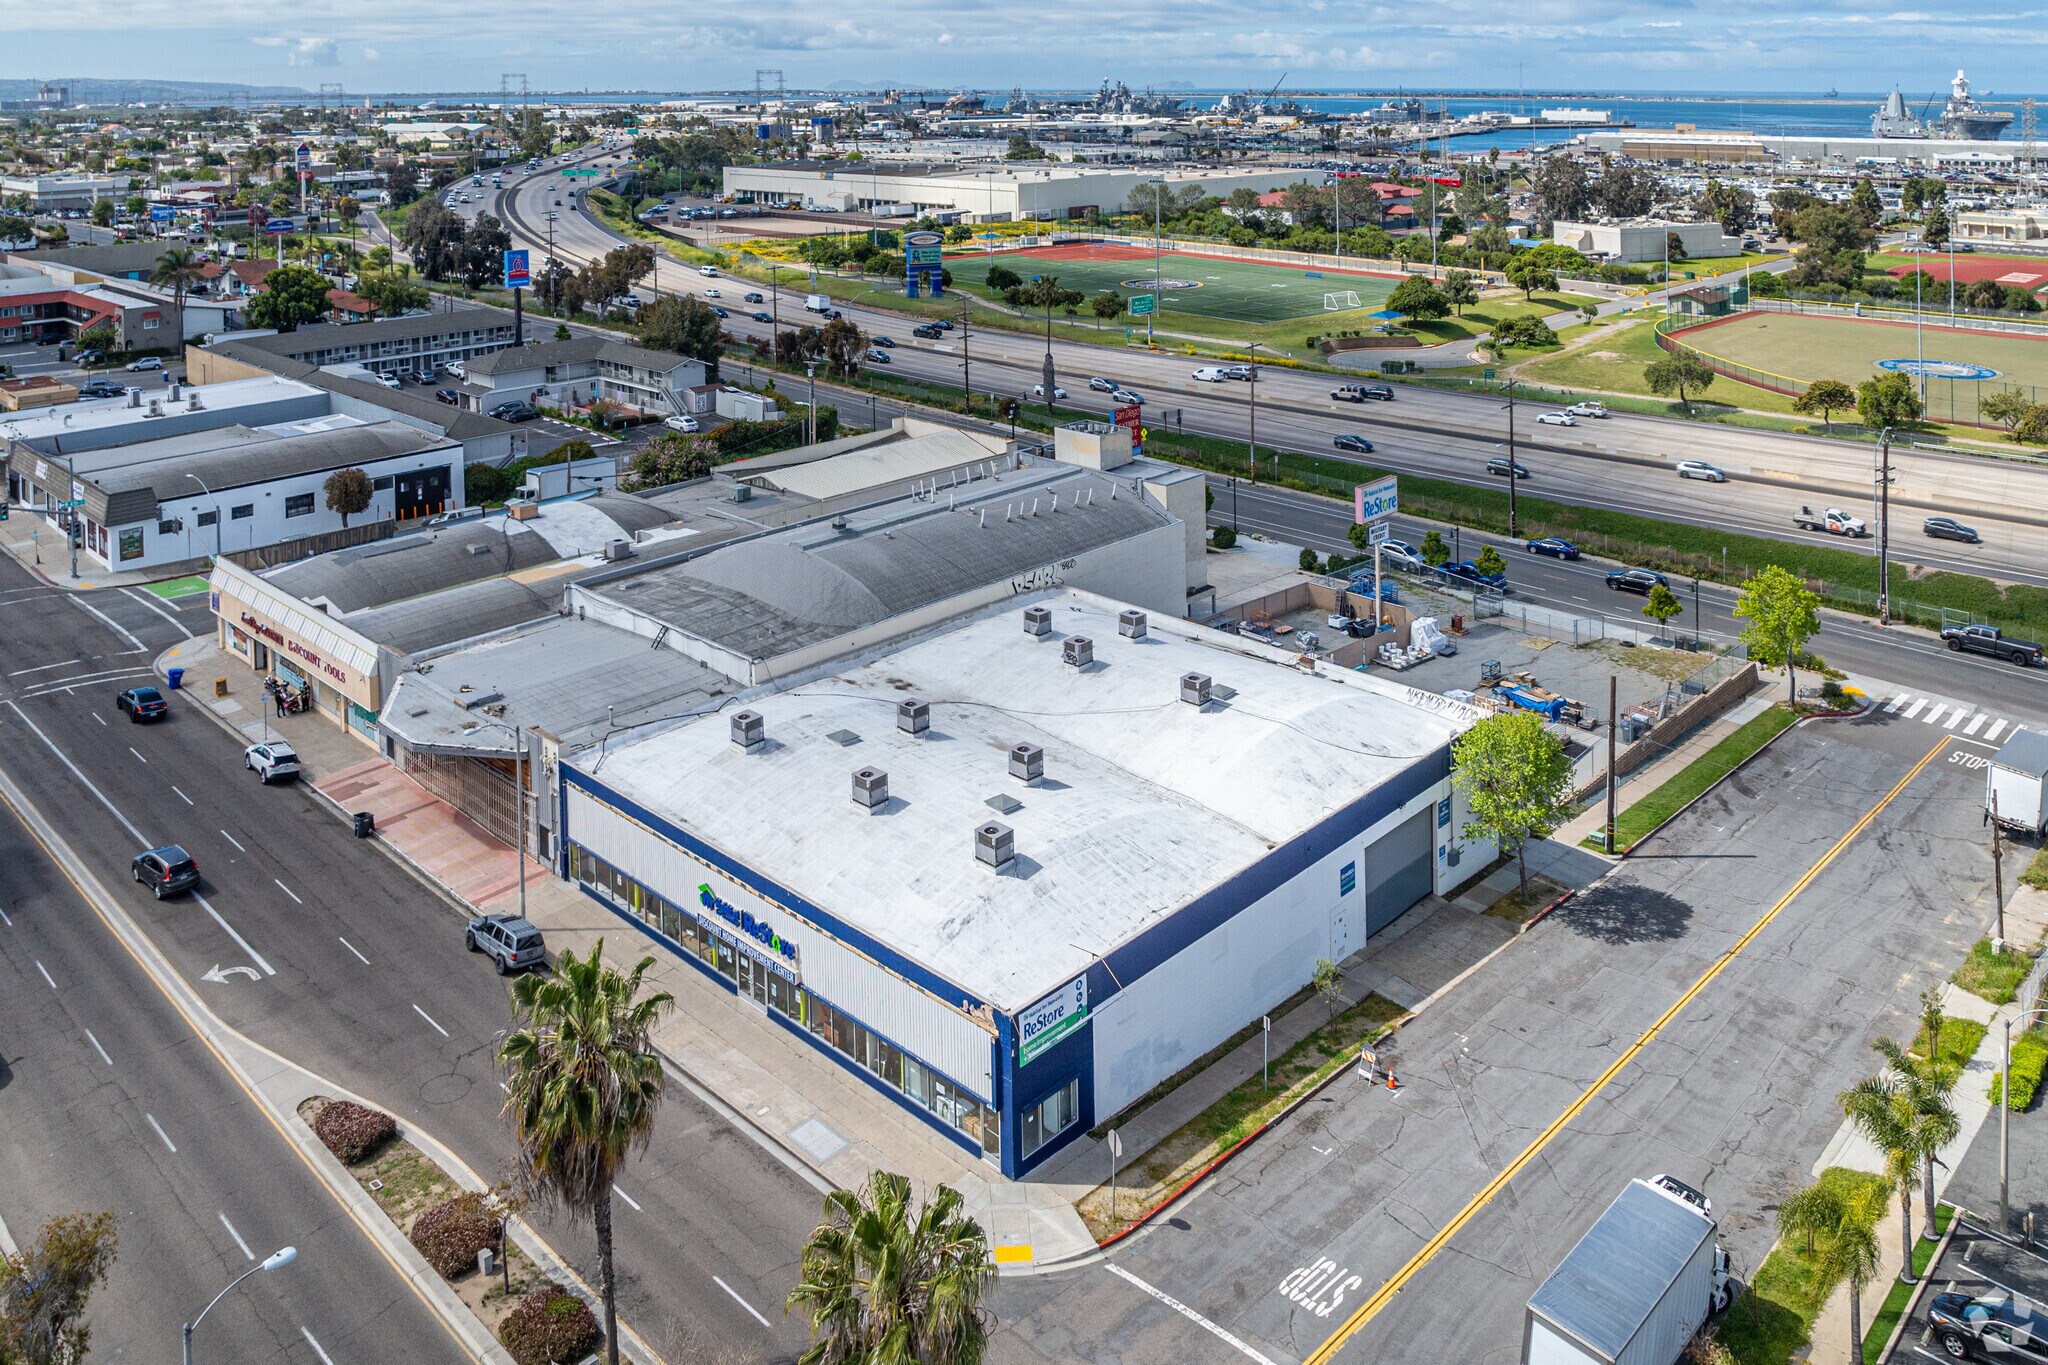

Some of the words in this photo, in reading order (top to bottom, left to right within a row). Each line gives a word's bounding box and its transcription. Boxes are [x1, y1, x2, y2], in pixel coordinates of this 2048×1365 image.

[513, 256, 524, 271] 6
[1115, 411, 1125, 421] San
[1125, 408, 1140, 418] Diego
[1363, 495, 1397, 518] ReStore
[1371, 525, 1387, 535] MILITARY
[1372, 532, 1386, 541] CREDIT
[288, 640, 322, 668] DISCOUNT
[323, 661, 346, 684] TOOLS
[1948, 751, 1989, 769] STOP
[742, 910, 796, 961] ReStore
[698, 914, 723, 937] DISCOUNT
[722, 929, 737, 946] HOME
[738, 938, 774, 969] IMPROVEMENT
[774, 961, 795, 983] CENTER
[1047, 993, 1064, 1006] Humanity
[1023, 1005, 1065, 1041] ReStore
